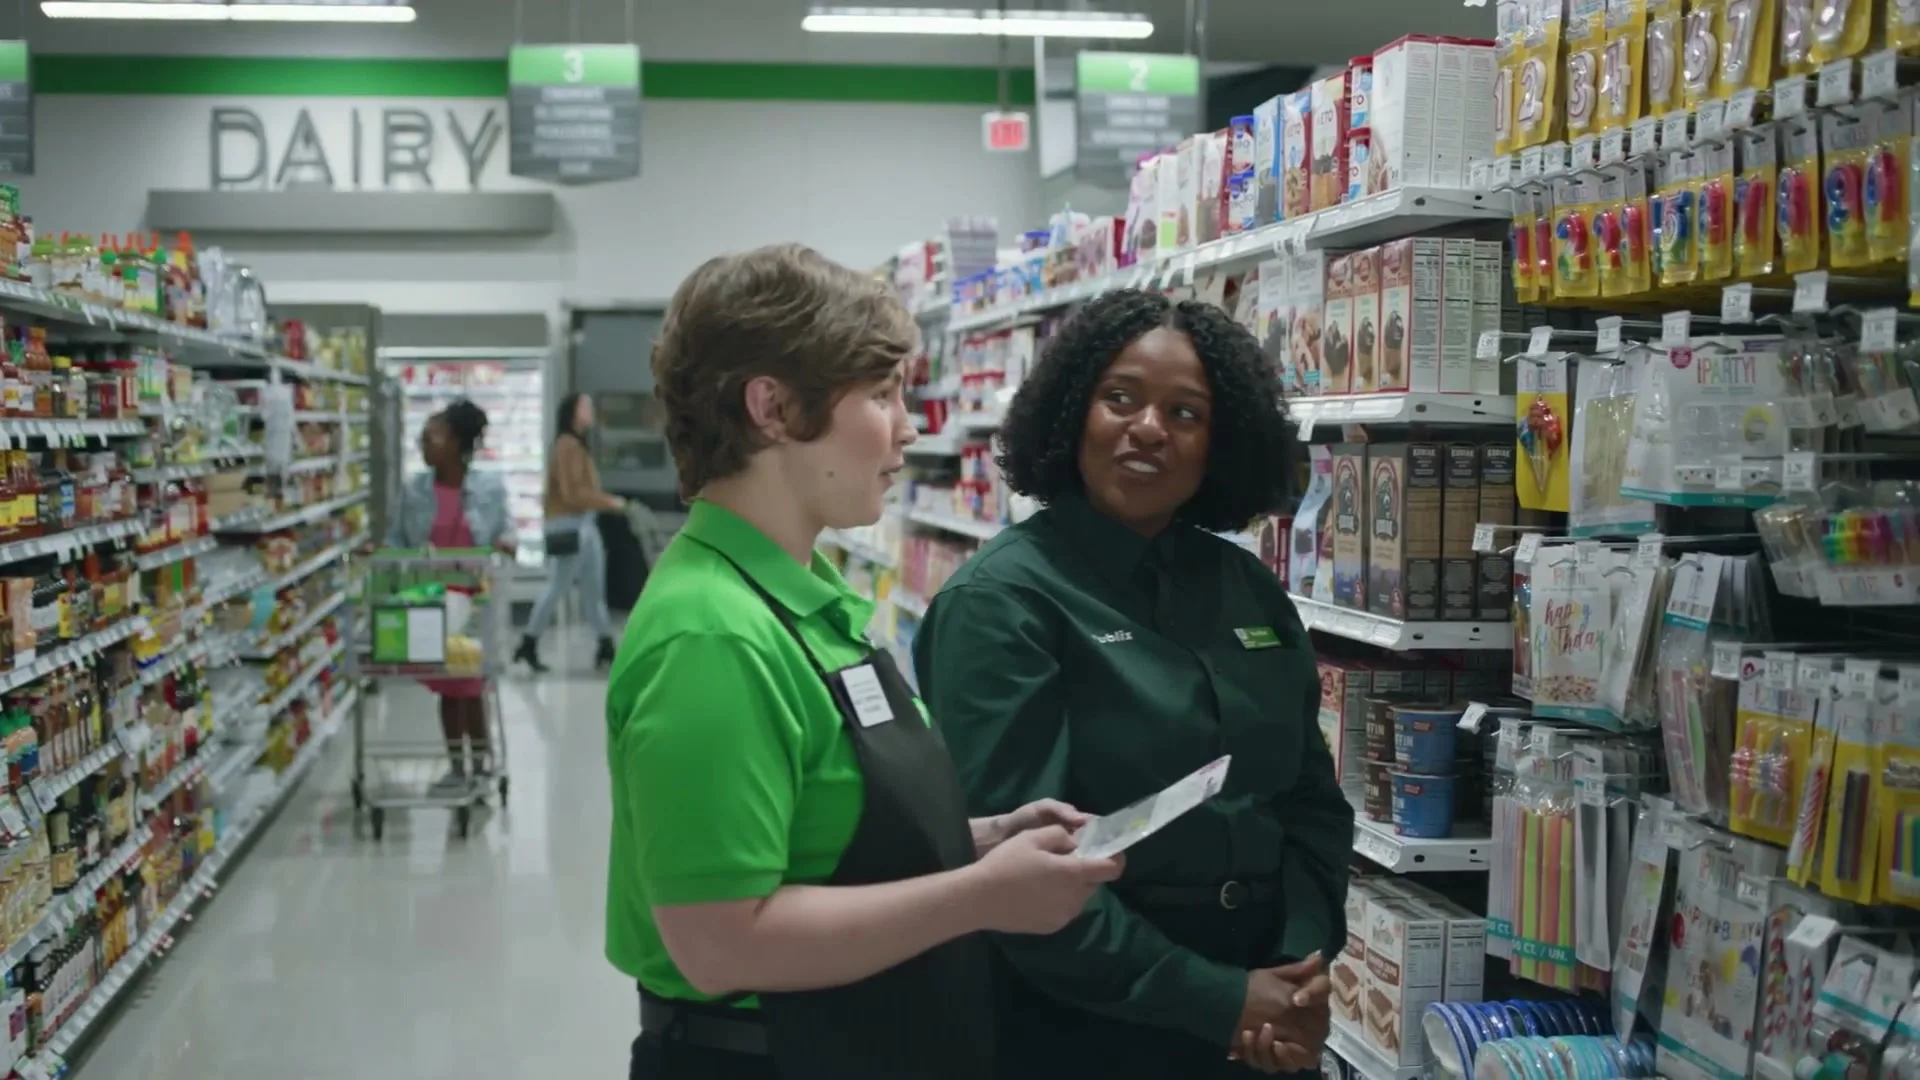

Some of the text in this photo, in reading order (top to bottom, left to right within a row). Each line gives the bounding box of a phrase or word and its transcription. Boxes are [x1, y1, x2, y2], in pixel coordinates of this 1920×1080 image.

[562, 49, 584, 83] 3
[1128, 58, 1150, 91] 2
[209, 106, 502, 188] DAIRY
[1092, 629, 1134, 644] ublix
